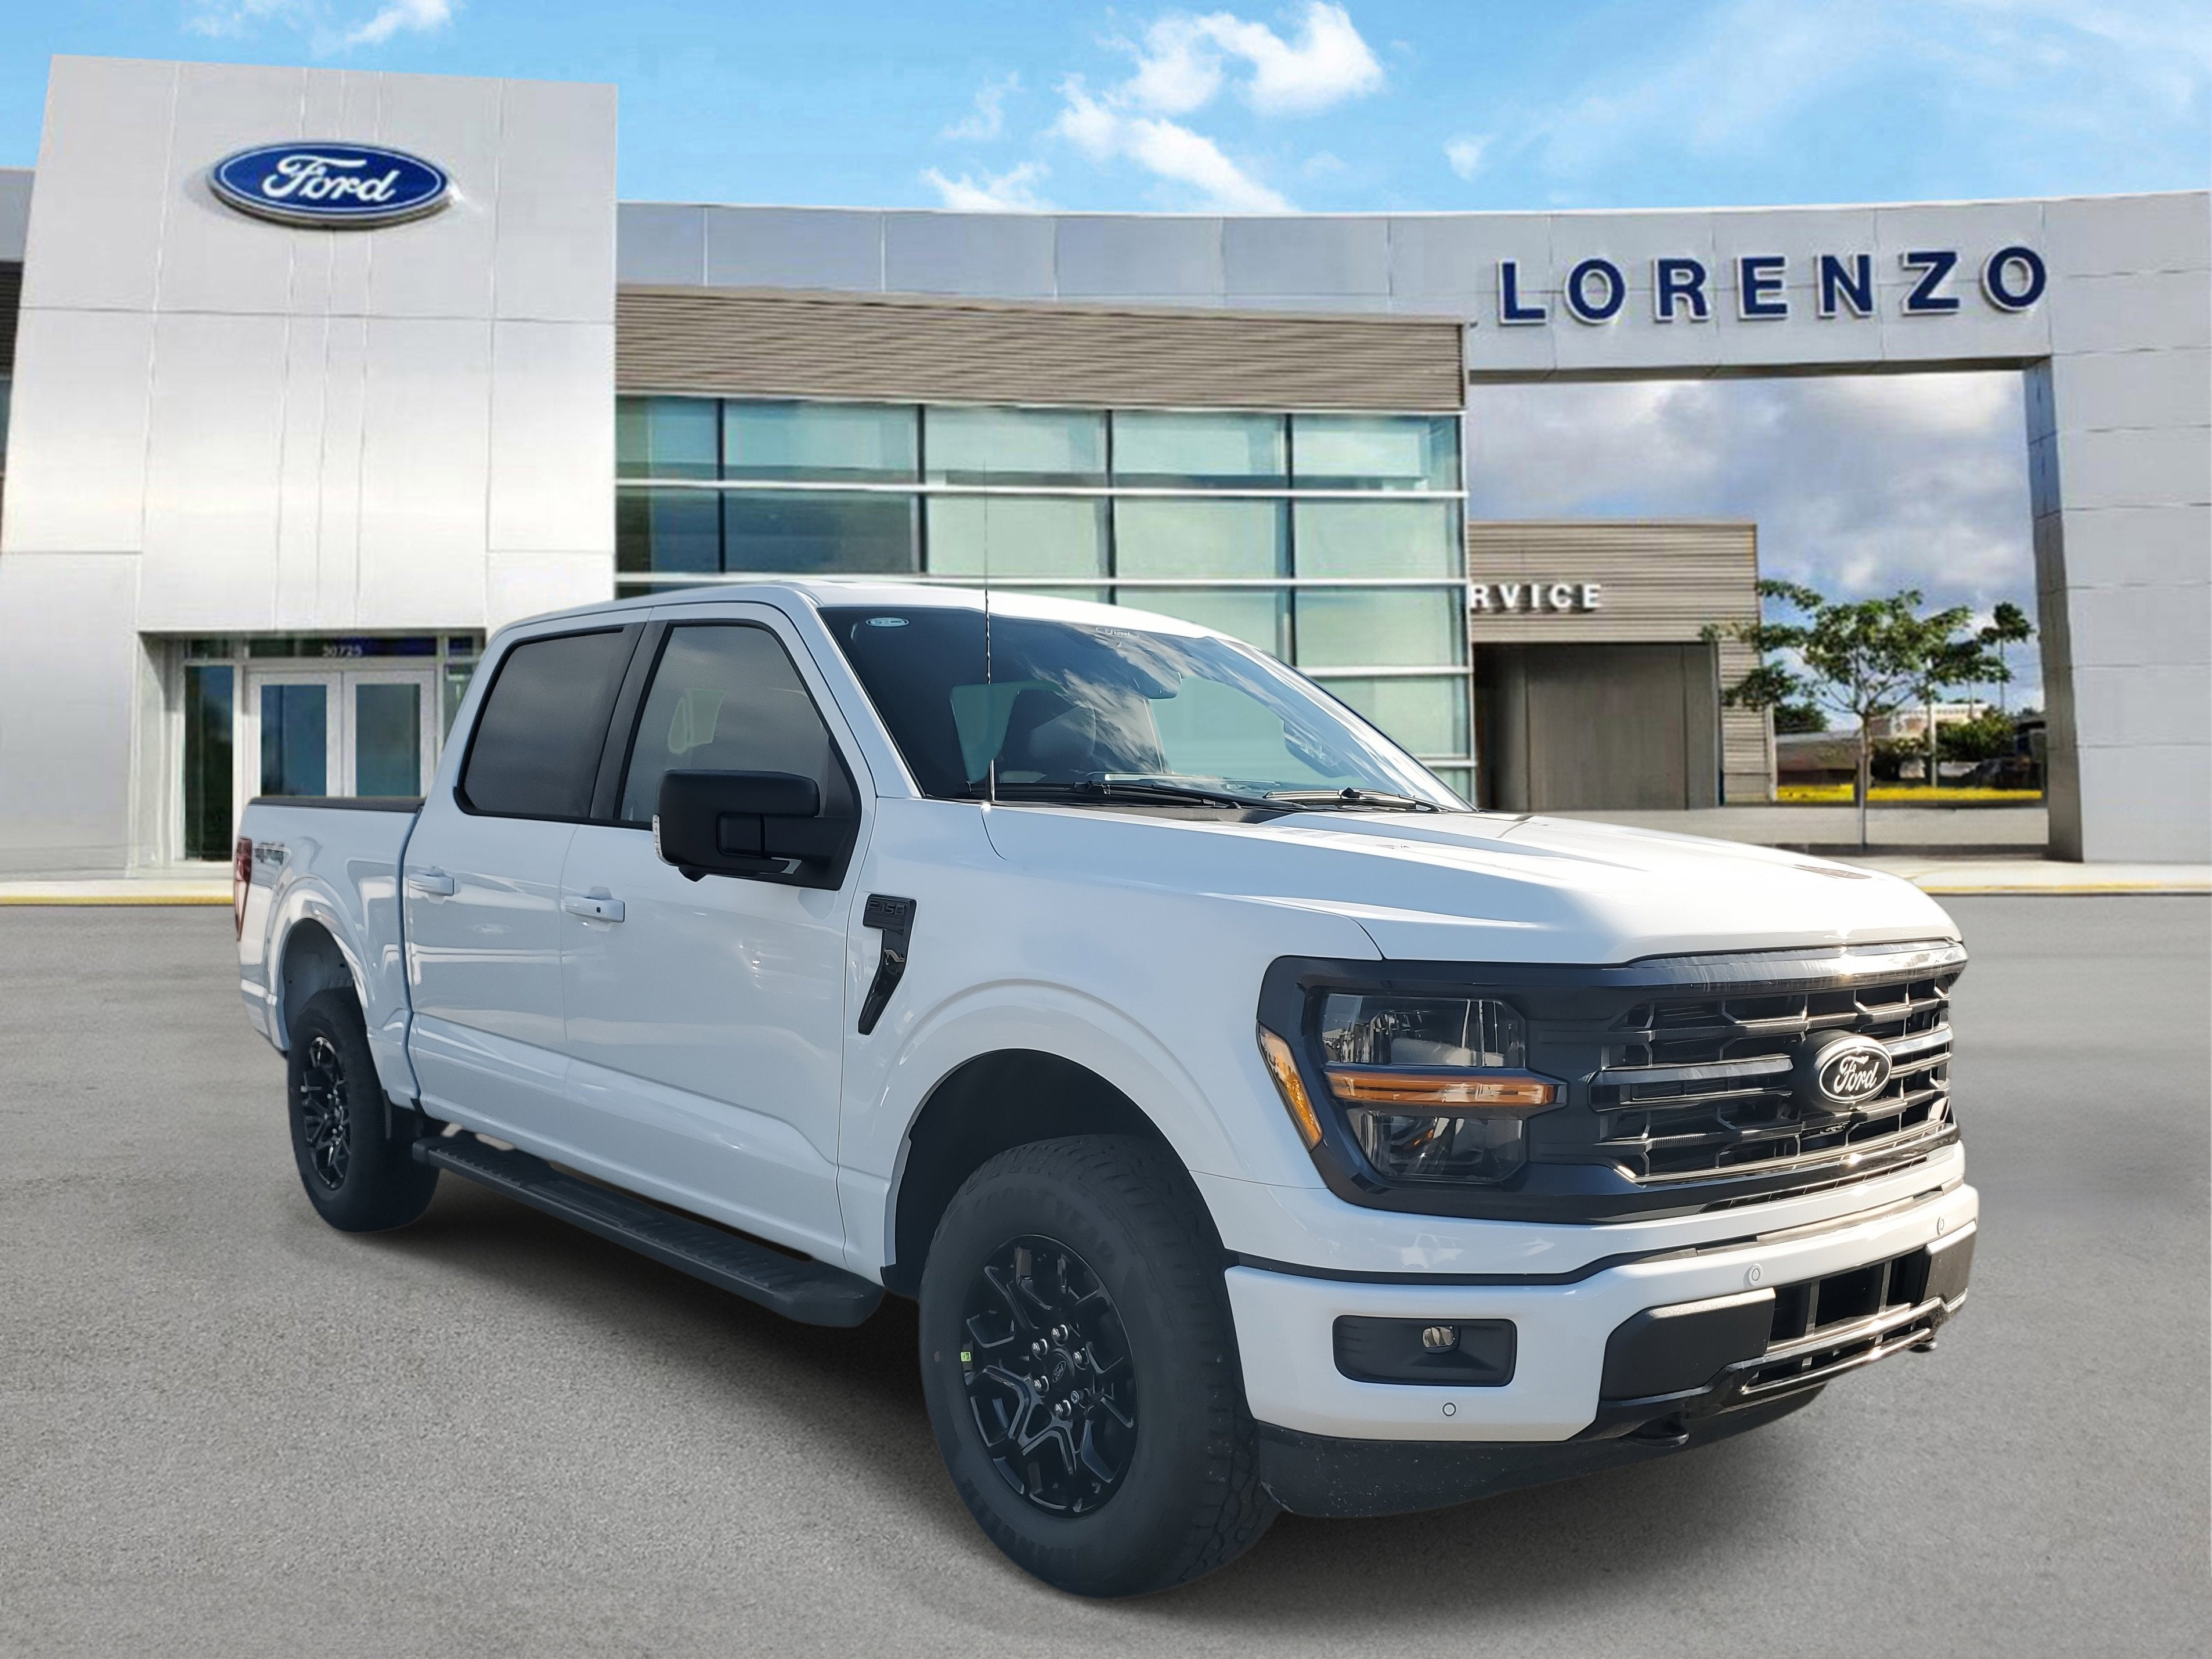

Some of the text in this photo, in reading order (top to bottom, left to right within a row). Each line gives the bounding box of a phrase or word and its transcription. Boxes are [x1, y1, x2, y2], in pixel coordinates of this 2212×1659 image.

[262, 154, 400, 201] Ford
[1499, 246, 2047, 322] LORENZO
[1834, 1055, 1879, 1094] Ford
